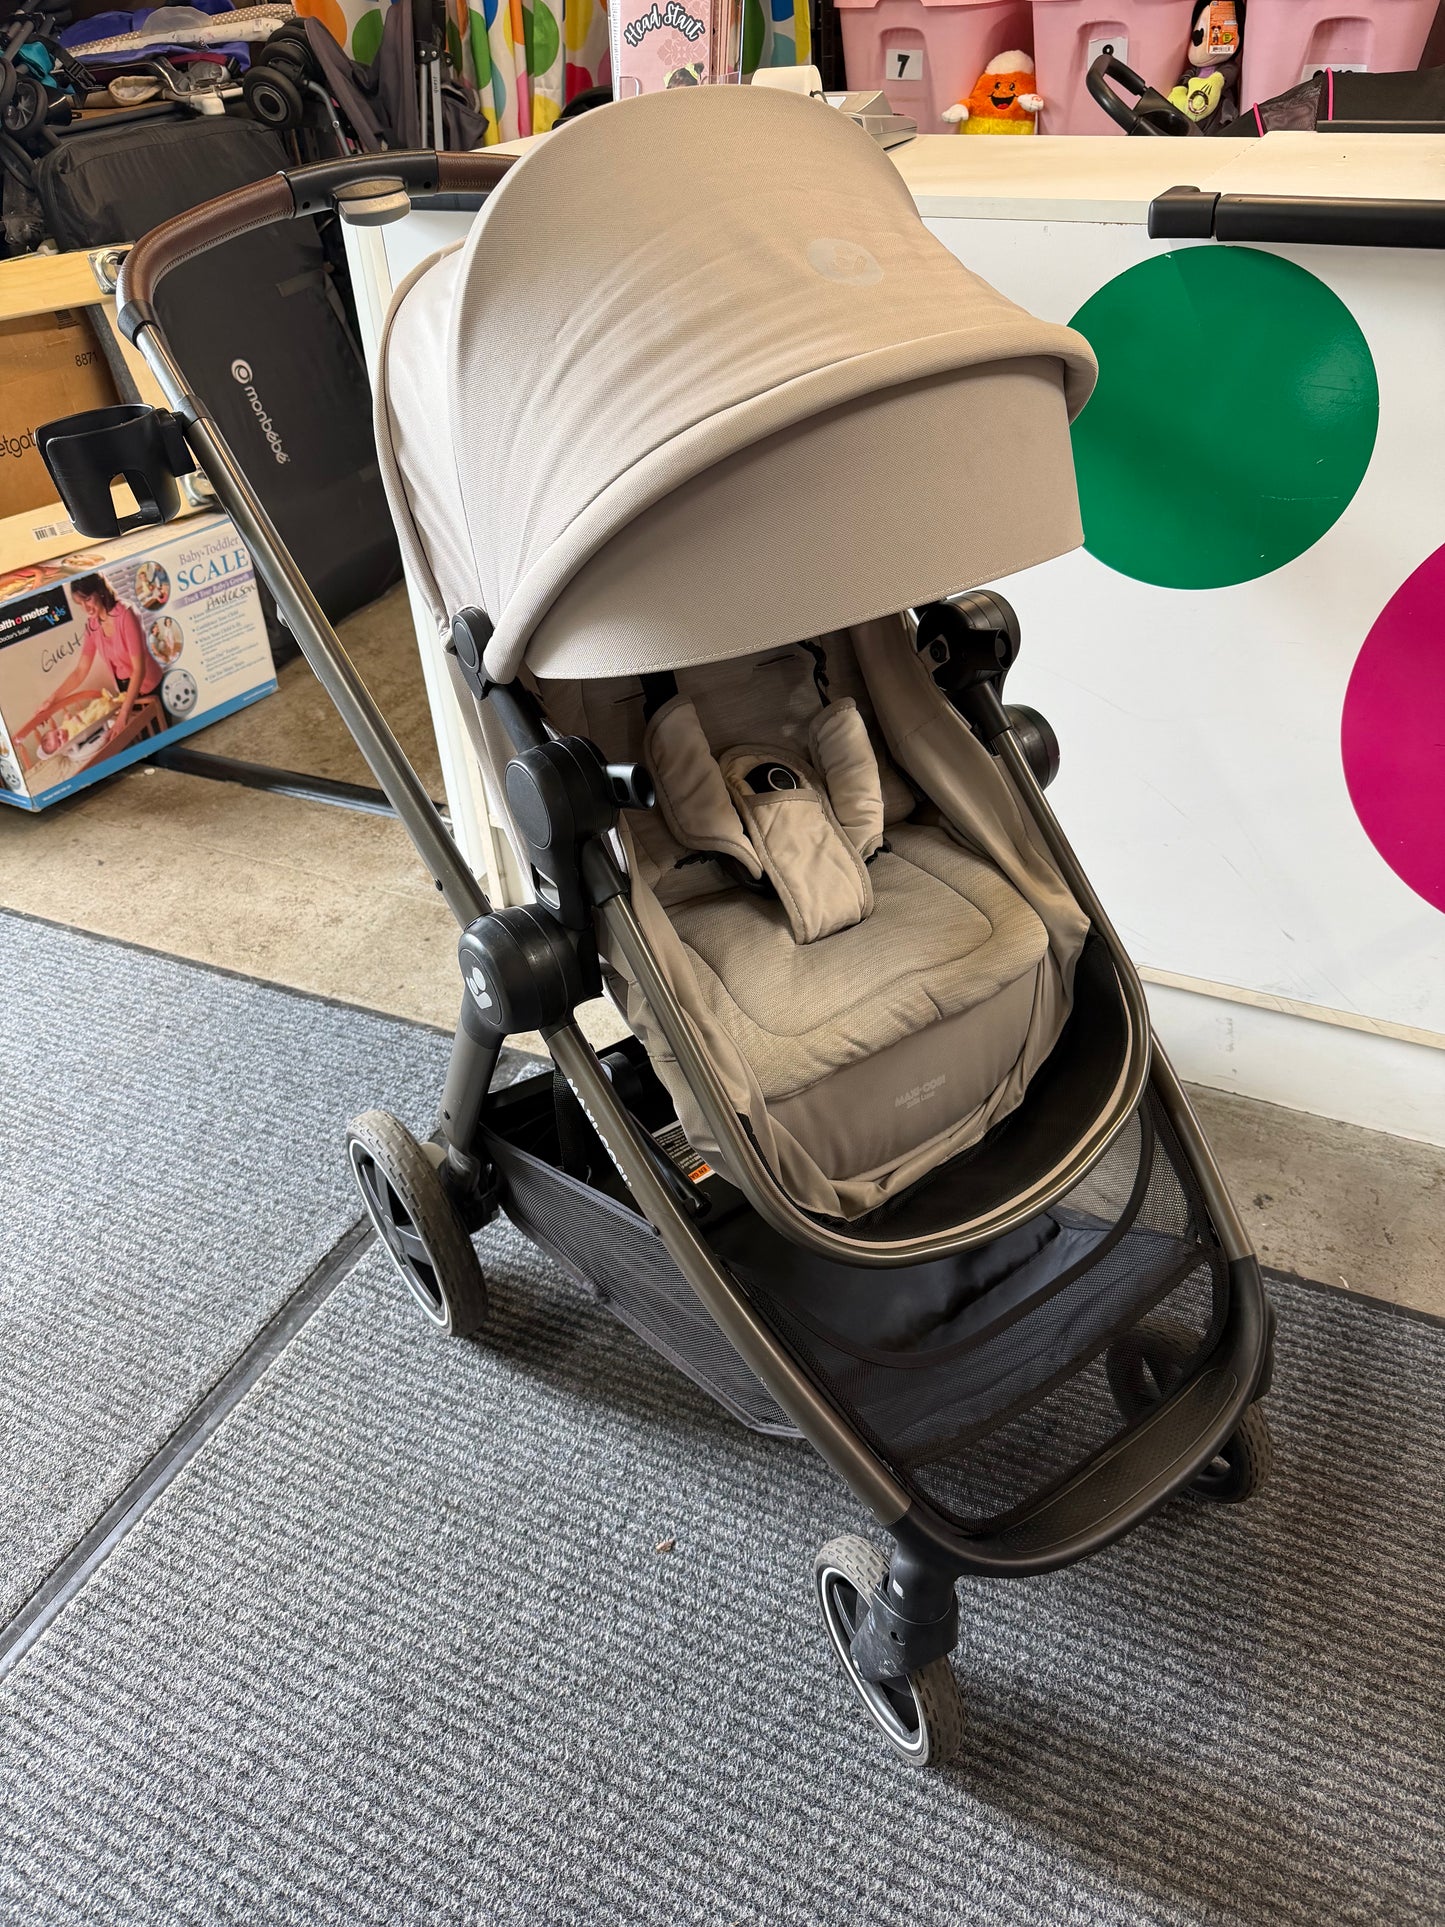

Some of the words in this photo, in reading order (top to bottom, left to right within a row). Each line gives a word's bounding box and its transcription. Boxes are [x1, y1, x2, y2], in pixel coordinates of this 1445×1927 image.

[624, 3, 661, 47] Head
[662, 1, 705, 42] Start
[896, 54, 910, 78] 7
[75, 351, 98, 367] 8871
[244, 386, 289, 464] monbébé
[177, 548, 249, 592] SCALE
